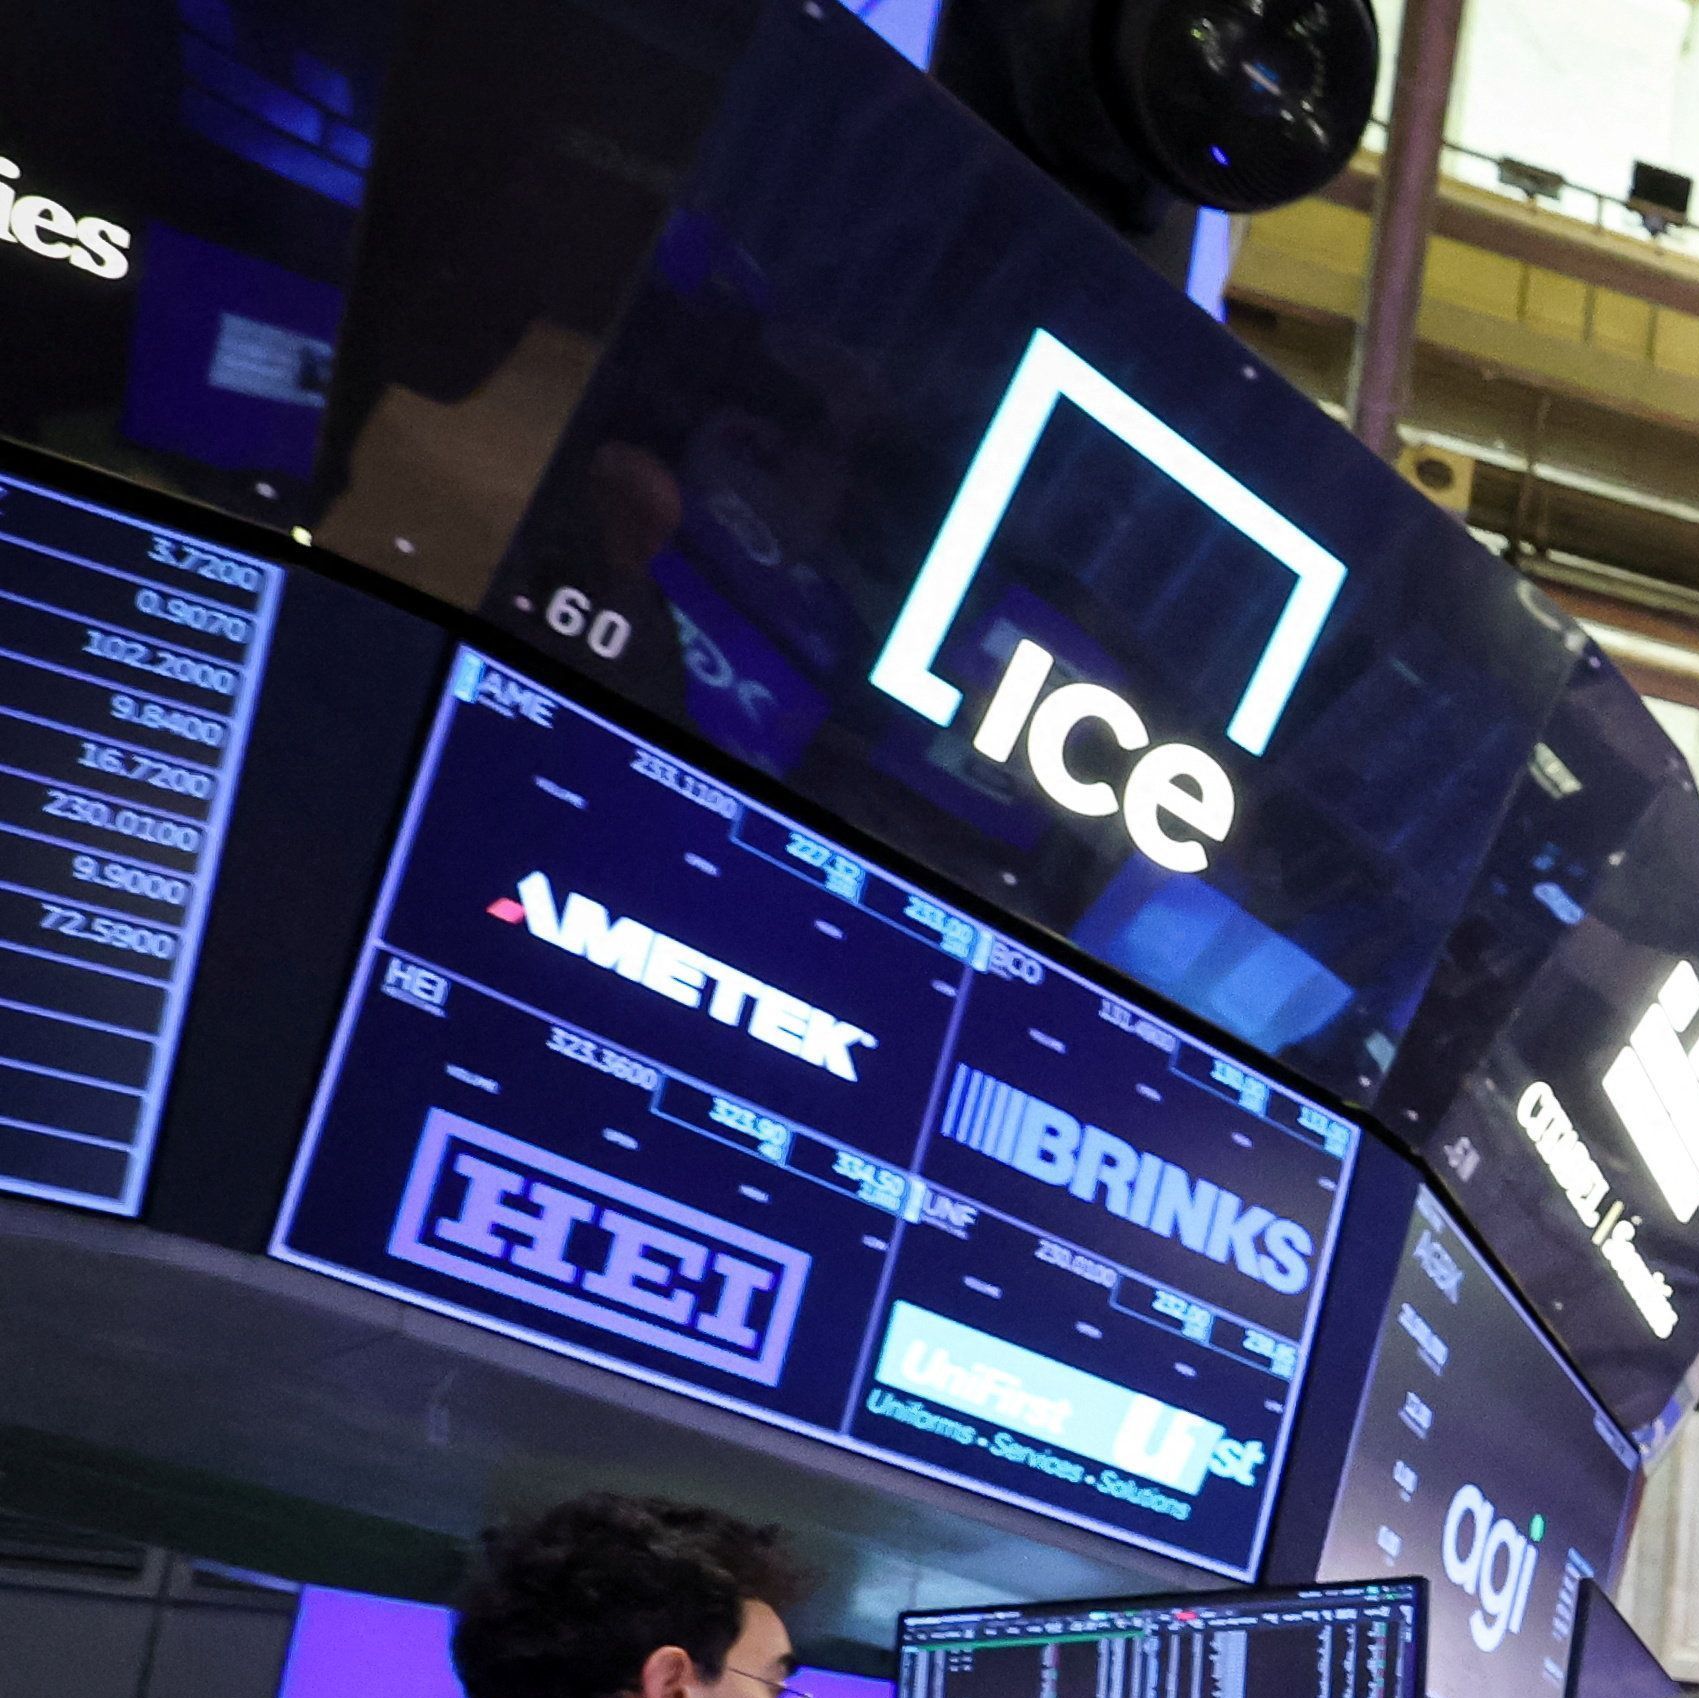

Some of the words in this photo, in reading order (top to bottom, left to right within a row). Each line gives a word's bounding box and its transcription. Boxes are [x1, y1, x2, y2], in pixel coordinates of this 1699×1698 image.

[135, 589, 251, 643] 0.9070
[147, 535, 264, 592] 3.7200
[545, 586, 632, 659] 60
[384, 957, 450, 1006] HEI
[486, 871, 879, 1083] AMETEK
[436, 1152, 775, 1350] HEI
[1003, 1090, 1314, 1296] BRINKS
[1442, 1483, 1546, 1653] agi
